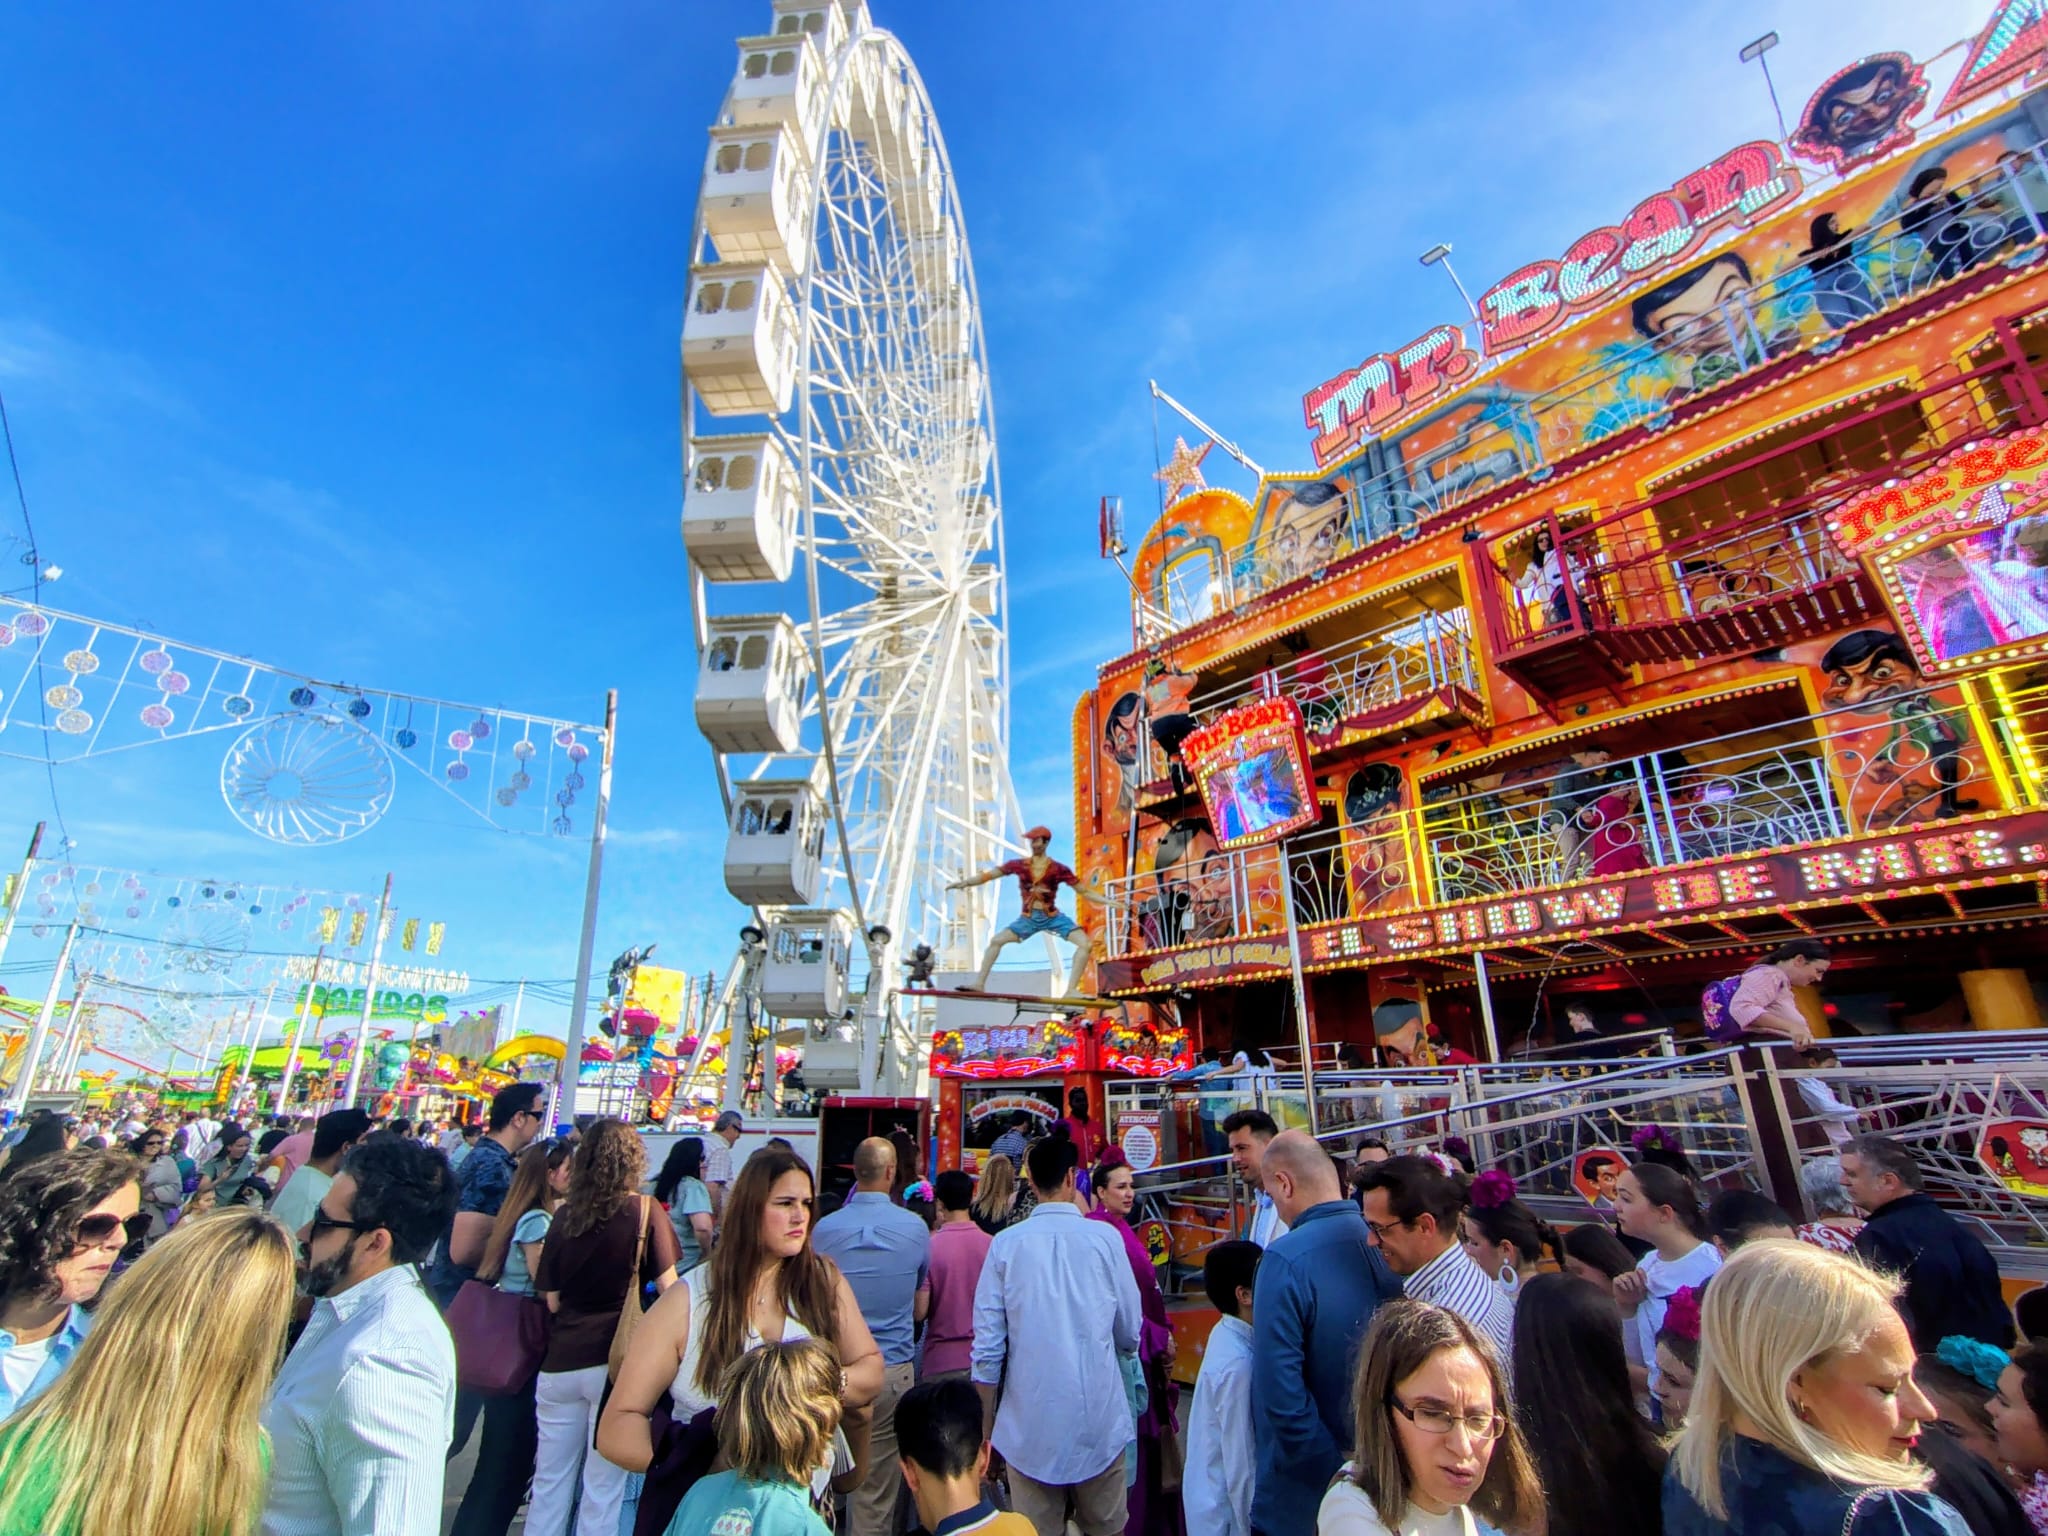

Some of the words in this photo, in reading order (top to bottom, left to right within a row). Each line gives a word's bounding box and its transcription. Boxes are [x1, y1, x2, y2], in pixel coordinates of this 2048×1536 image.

[1480, 141, 1801, 355] Bean
[1212, 945, 1232, 966] LA
[1310, 925, 1377, 962] EL
[1387, 885, 1628, 950] SHOW
[1651, 862, 1777, 913] DE
